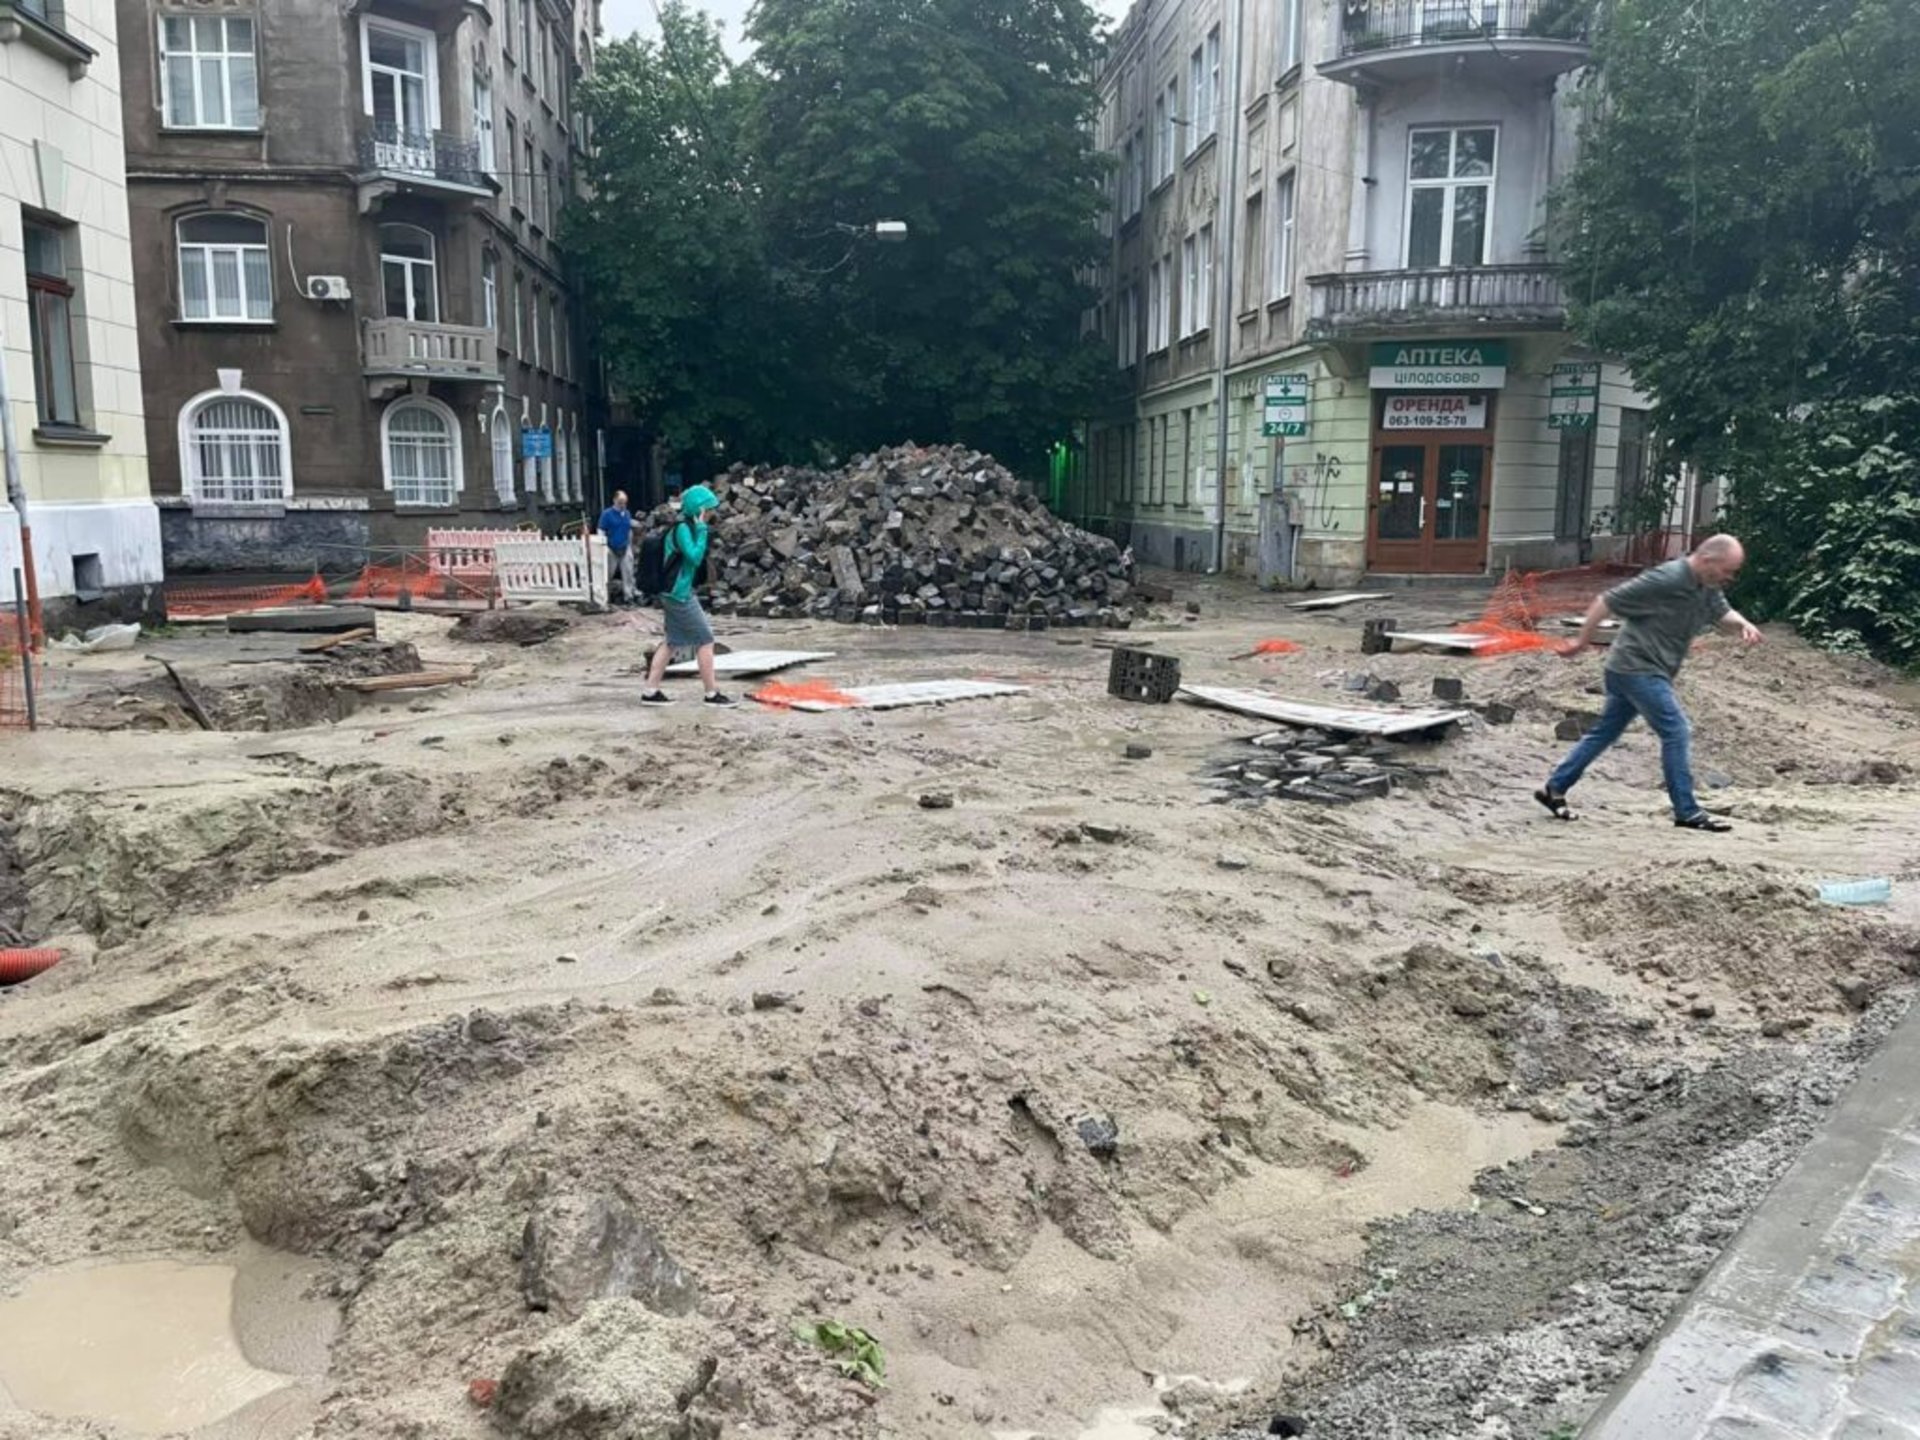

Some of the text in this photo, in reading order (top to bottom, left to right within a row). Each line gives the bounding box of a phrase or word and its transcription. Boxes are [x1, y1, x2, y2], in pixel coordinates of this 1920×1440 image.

[1394, 347, 1483, 365] АПТЕКА
[1394, 372, 1480, 385] ЦІЛОДОБОВО
[1392, 398, 1465, 414] ОРЕНДА
[1269, 423, 1300, 434] 24/7
